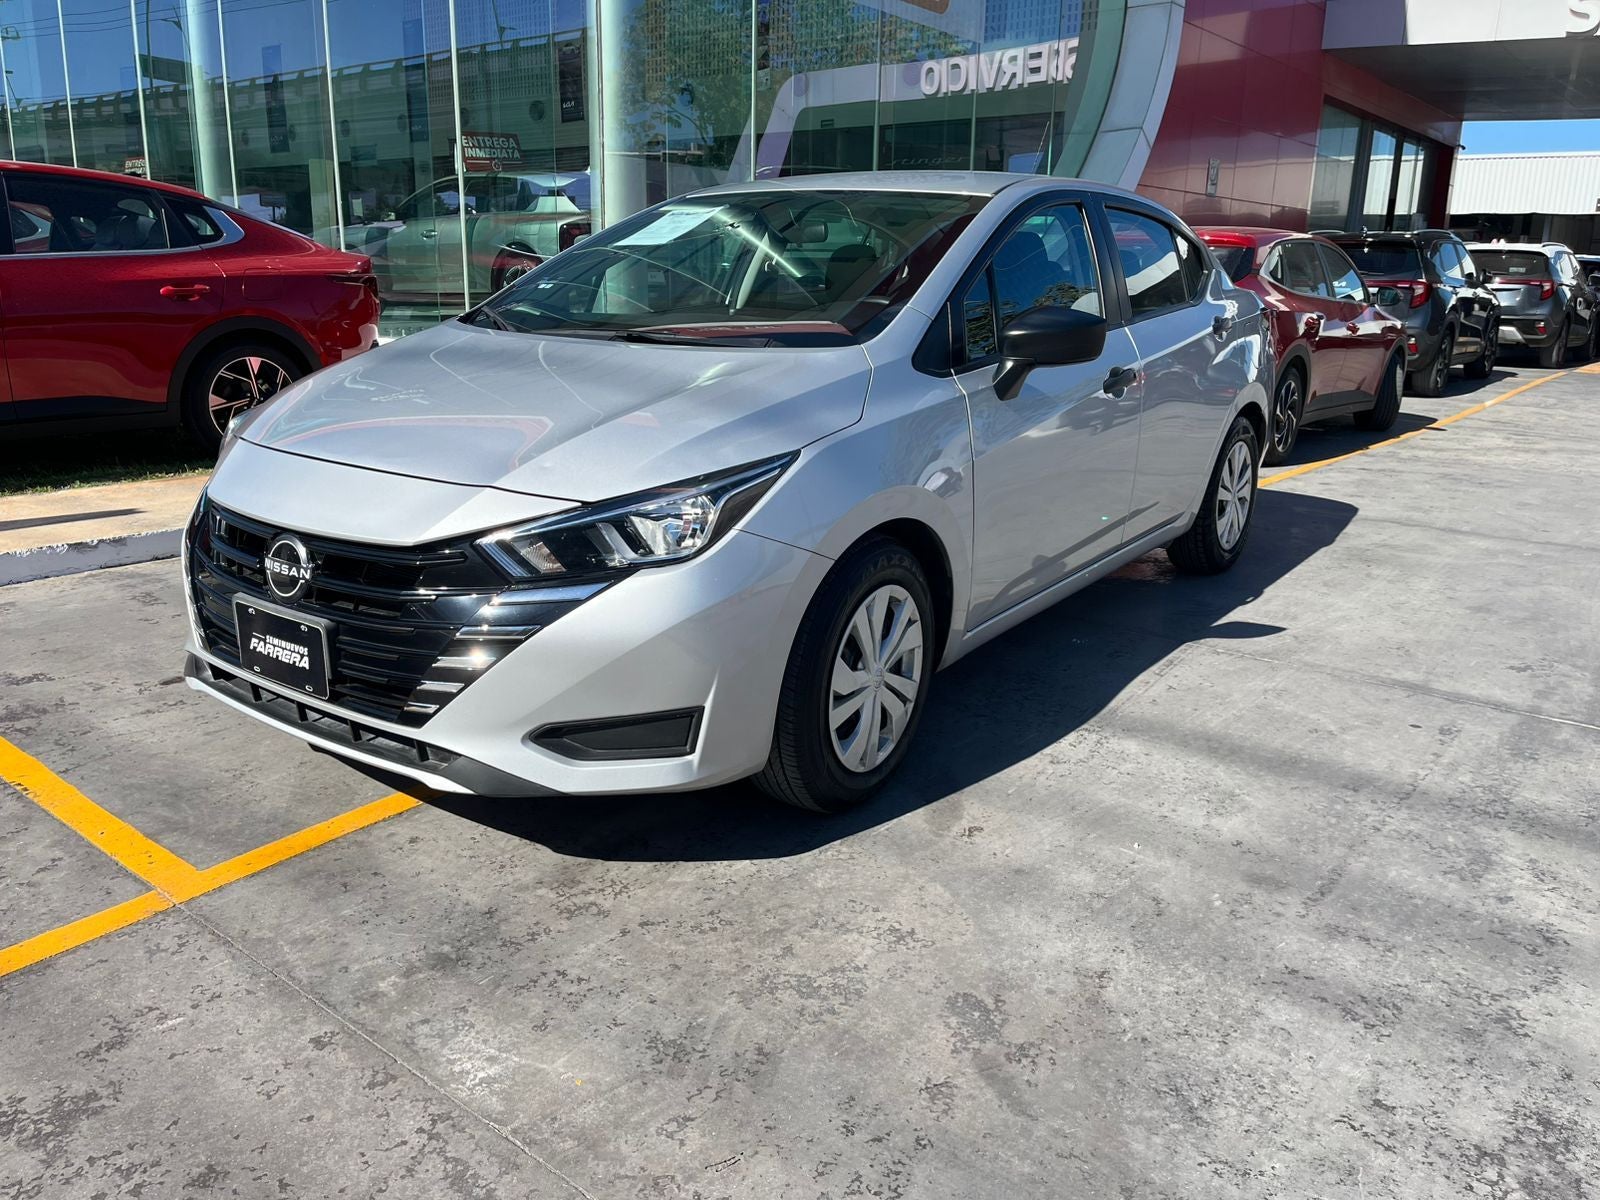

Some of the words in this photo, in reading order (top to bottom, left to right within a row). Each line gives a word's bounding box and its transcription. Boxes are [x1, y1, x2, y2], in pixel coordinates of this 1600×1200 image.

[1566, 0, 1600, 34] S
[461, 135, 517, 148] ENTREGA
[464, 147, 520, 159] INMEDIATA
[264, 557, 311, 580] NISSAN
[250, 638, 309, 670] FARRERA
[266, 635, 308, 655] SEMINUEVOS
